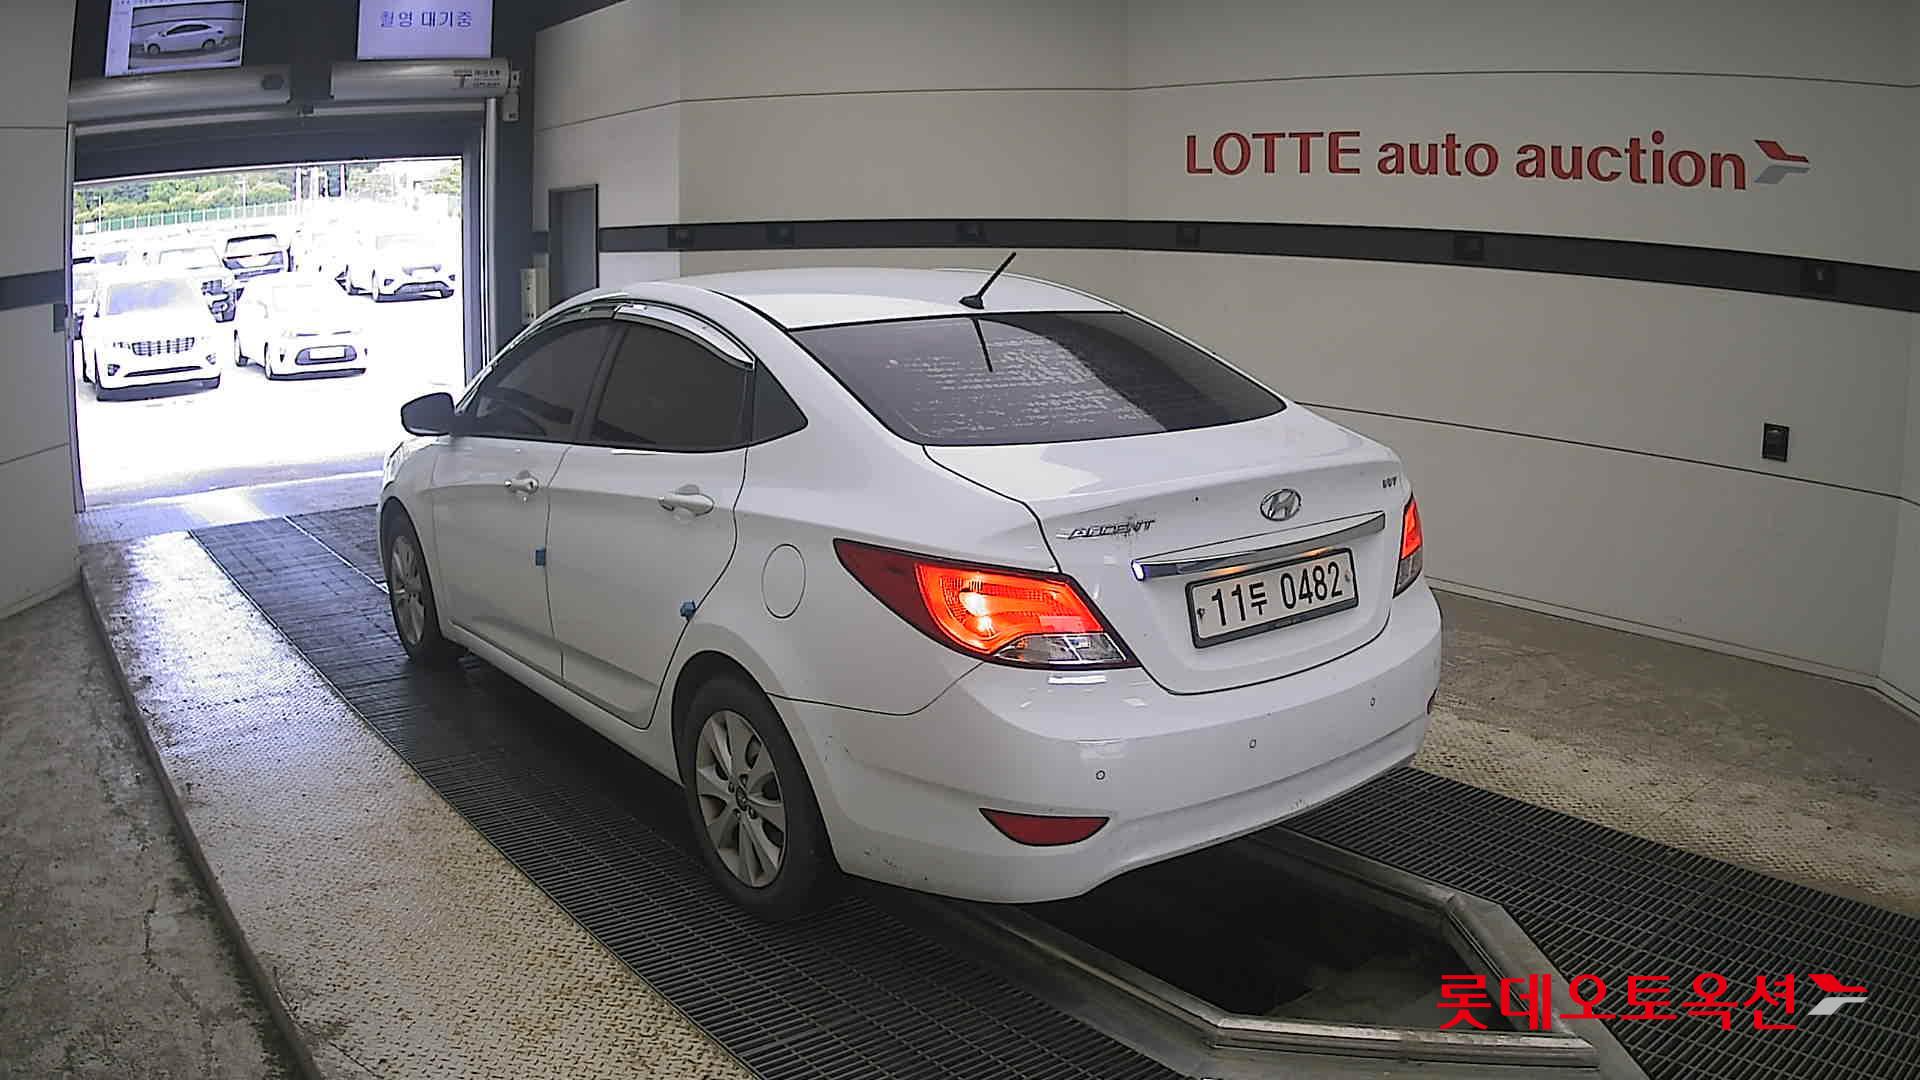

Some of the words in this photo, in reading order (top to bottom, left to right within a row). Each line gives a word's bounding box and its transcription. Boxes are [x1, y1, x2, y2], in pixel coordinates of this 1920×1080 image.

[421, 11, 472, 27] 대기중
[1186, 131, 1361, 176] LOTTE
[1377, 132, 1499, 177] auto
[1515, 130, 1747, 190] auction
[1068, 519, 1156, 540] ACCENT
[1211, 582, 1268, 627] 11두
[1280, 561, 1343, 610] 0482
